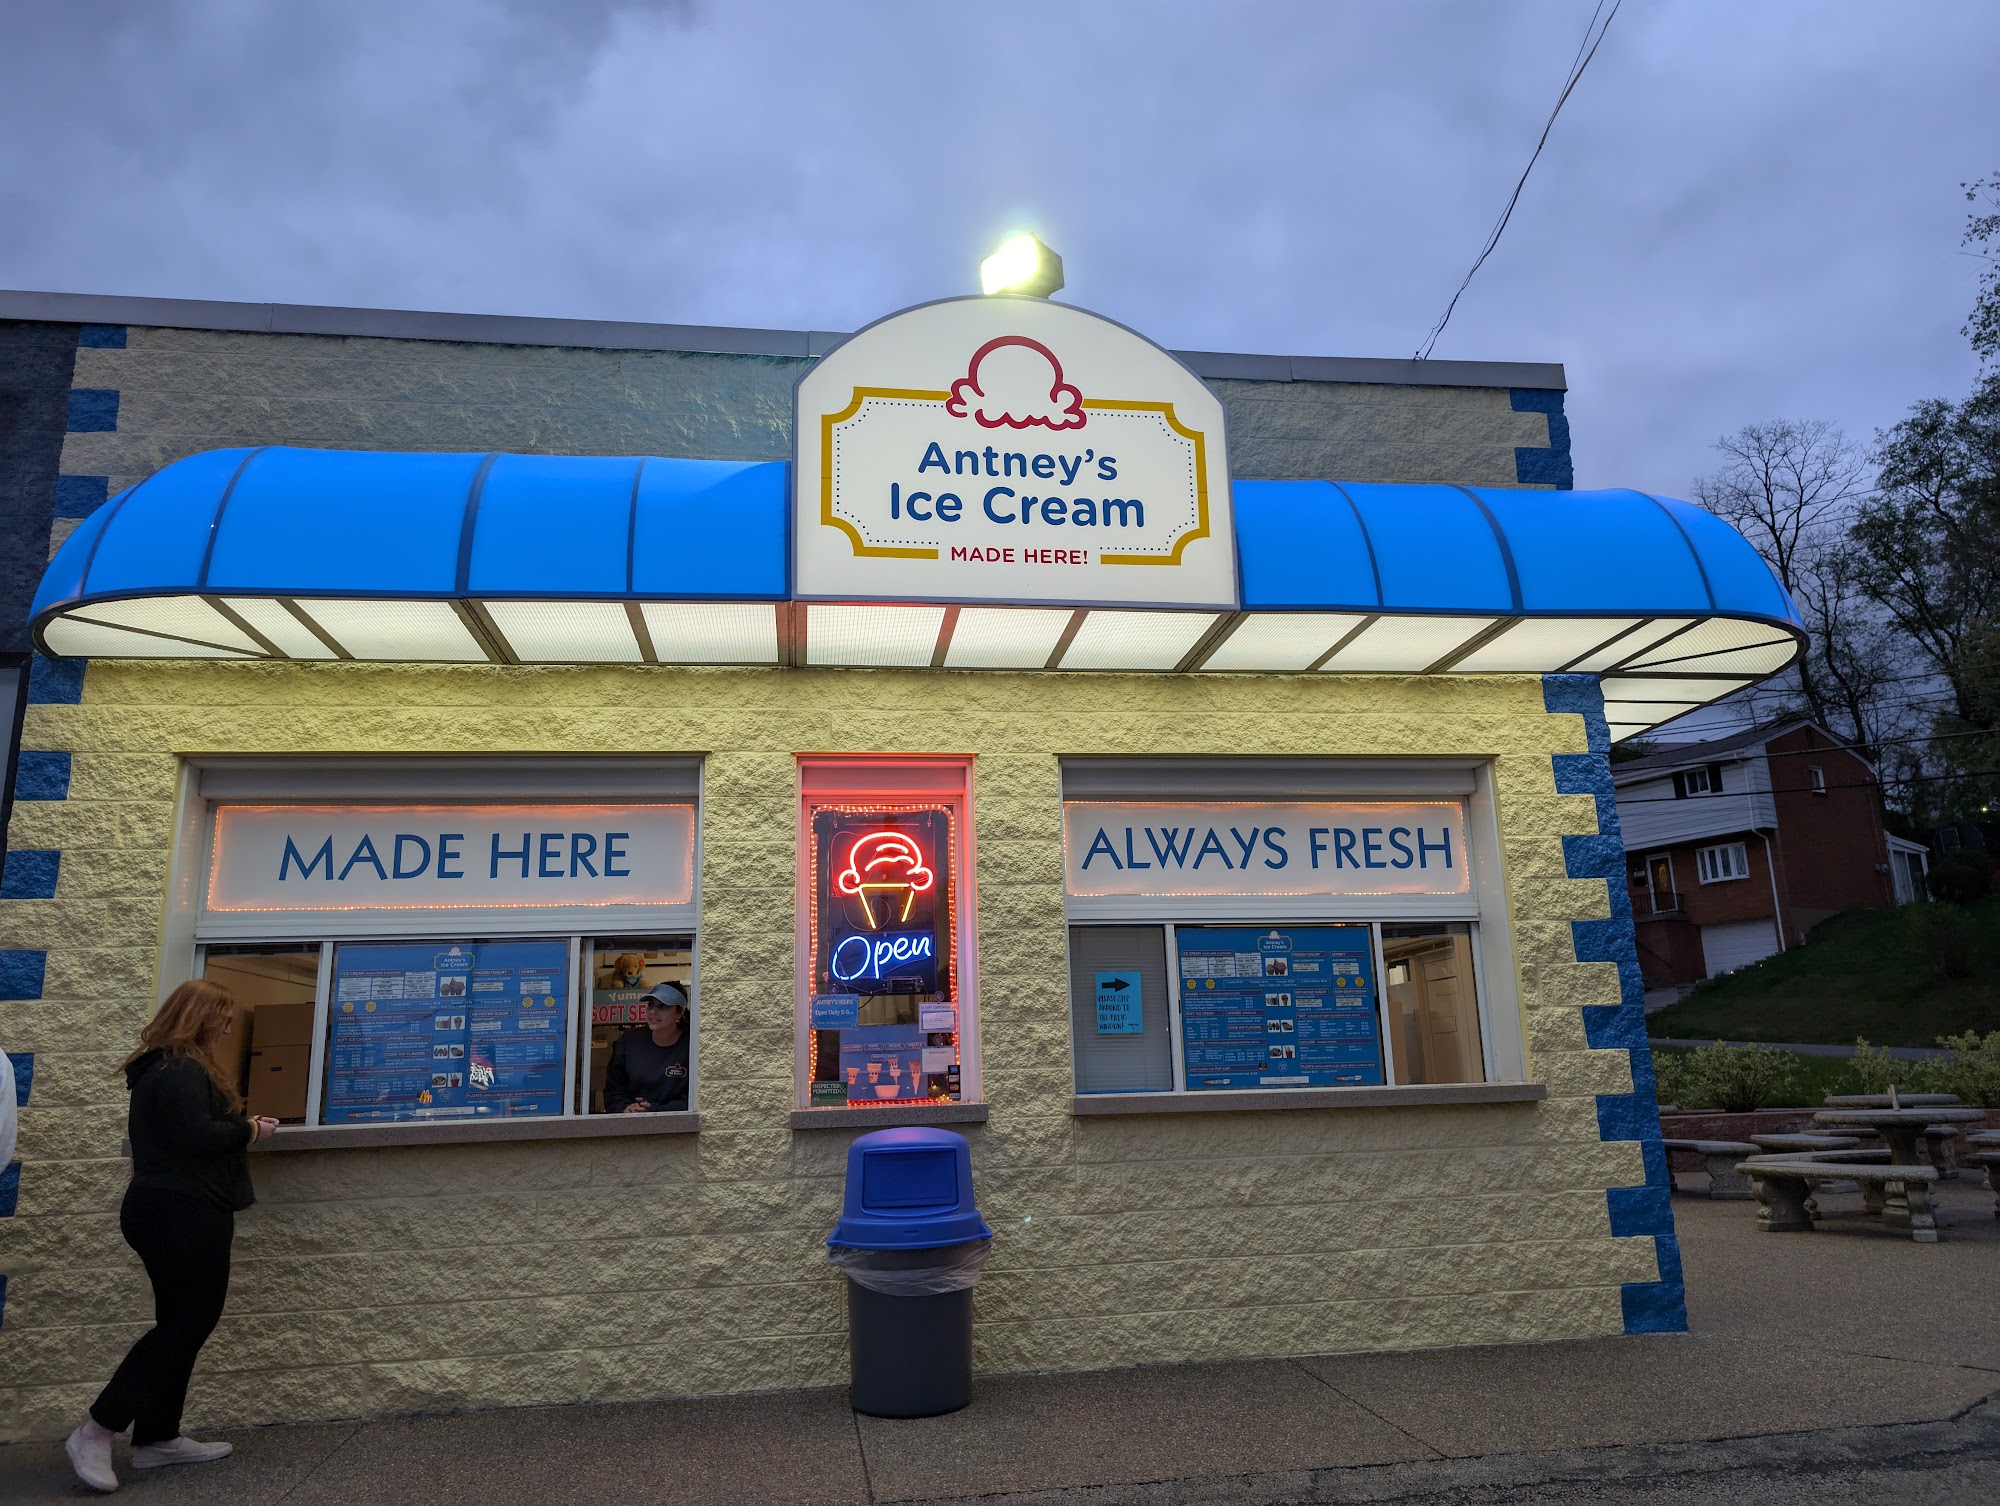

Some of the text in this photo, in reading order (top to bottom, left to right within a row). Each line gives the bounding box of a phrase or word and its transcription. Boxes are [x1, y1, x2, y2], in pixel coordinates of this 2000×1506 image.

[918, 441, 1118, 486] Antney's
[891, 482, 1144, 527] Ice Cream
[951, 546, 1088, 565] MADE HERE!
[279, 832, 631, 881] MADE HERE
[1081, 826, 1453, 870] ALWAYS FRESH
[832, 935, 931, 981] Open
[592, 1004, 625, 1023] SOFT
